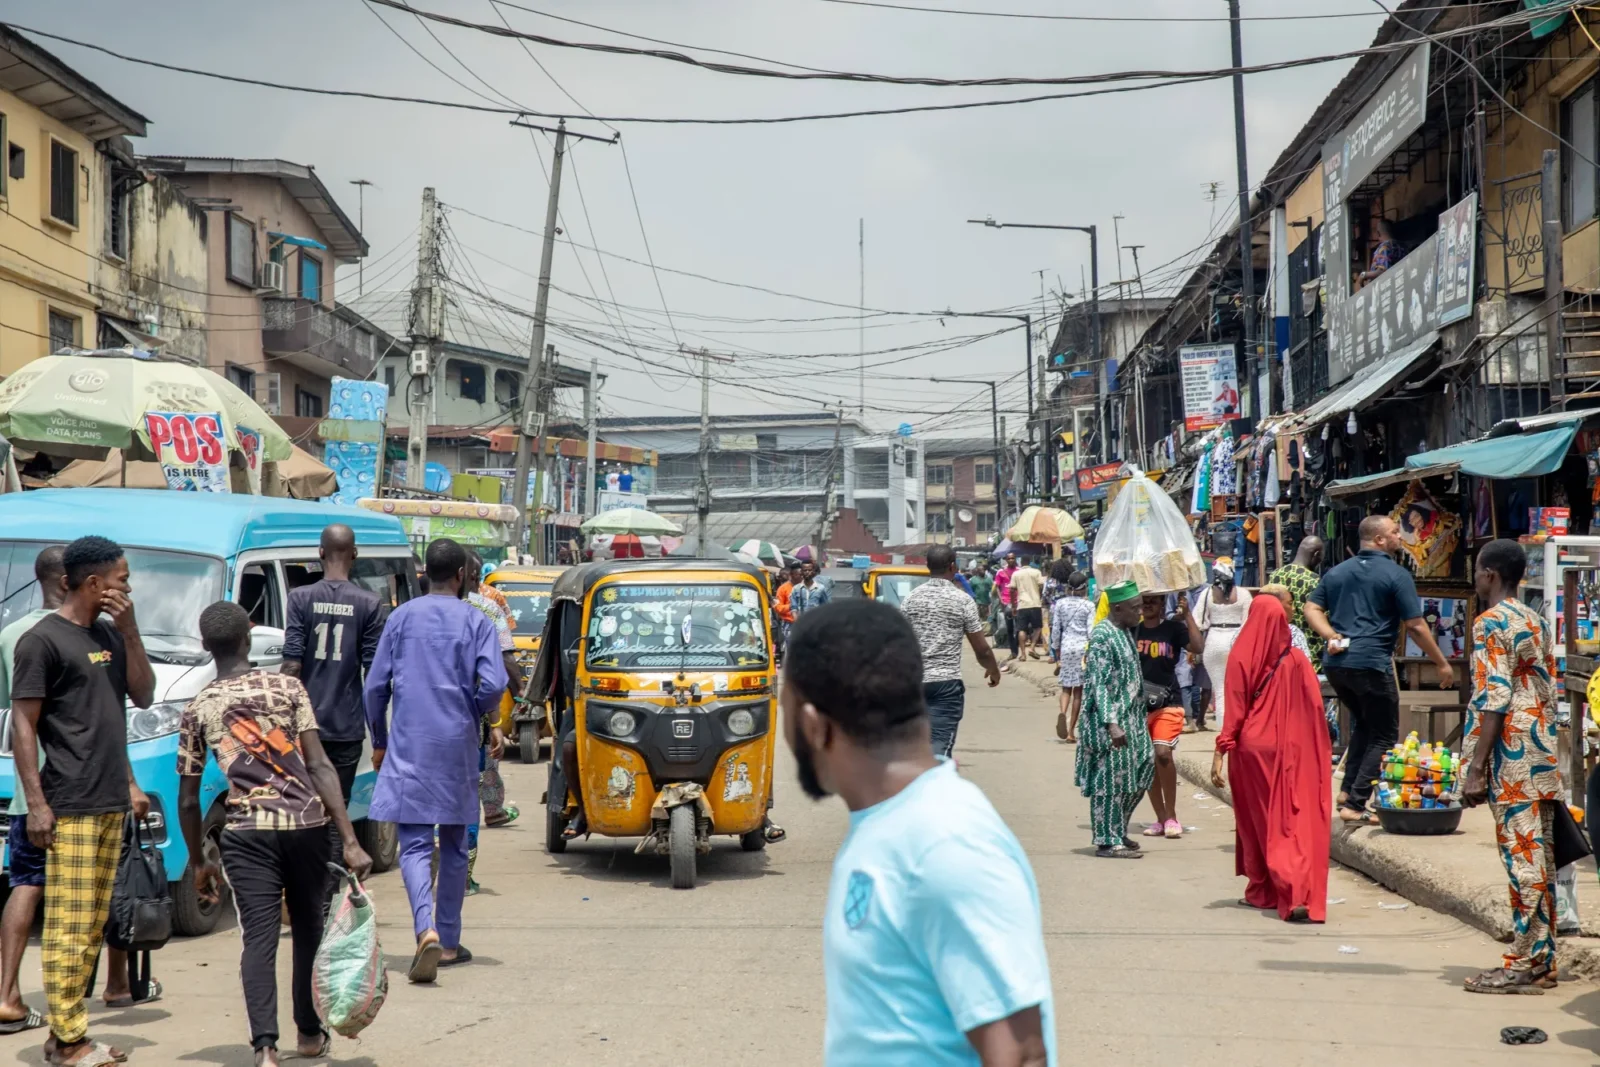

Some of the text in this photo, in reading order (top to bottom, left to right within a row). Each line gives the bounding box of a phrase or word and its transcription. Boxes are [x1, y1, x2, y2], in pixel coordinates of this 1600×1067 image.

[1325, 178, 1340, 211] LIVE
[74, 371, 105, 387] glo
[54, 392, 108, 405] Unlimited
[50, 416, 97, 429] VOICE AND
[46, 427, 102, 440] DATA PLANS
[145, 413, 223, 465] POS
[167, 468, 210, 478] IS HERE
[314, 622, 344, 661] 11
[676, 725, 690, 734] RE
